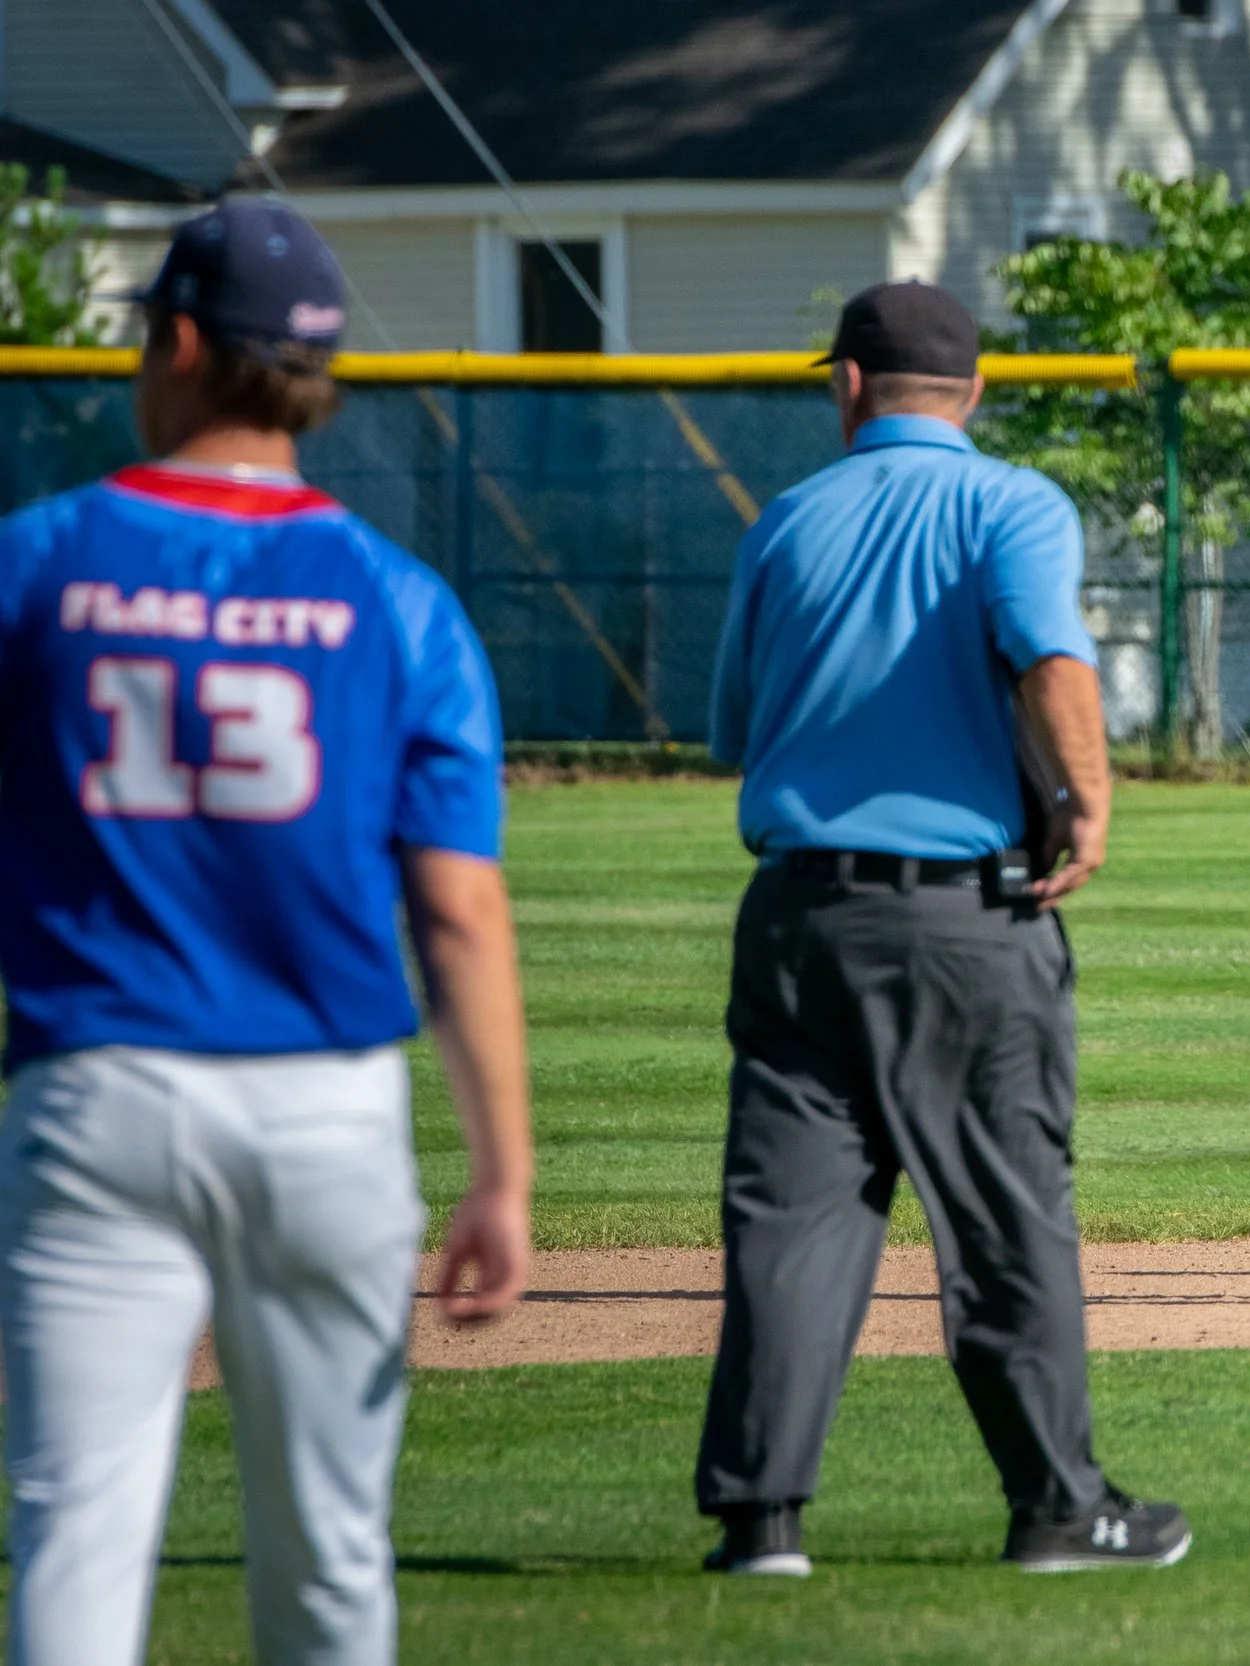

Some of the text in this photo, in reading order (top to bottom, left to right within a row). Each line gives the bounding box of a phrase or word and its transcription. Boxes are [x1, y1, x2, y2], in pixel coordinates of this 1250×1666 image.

[60, 580, 356, 651] FLAG CITY
[80, 655, 323, 823] 13
